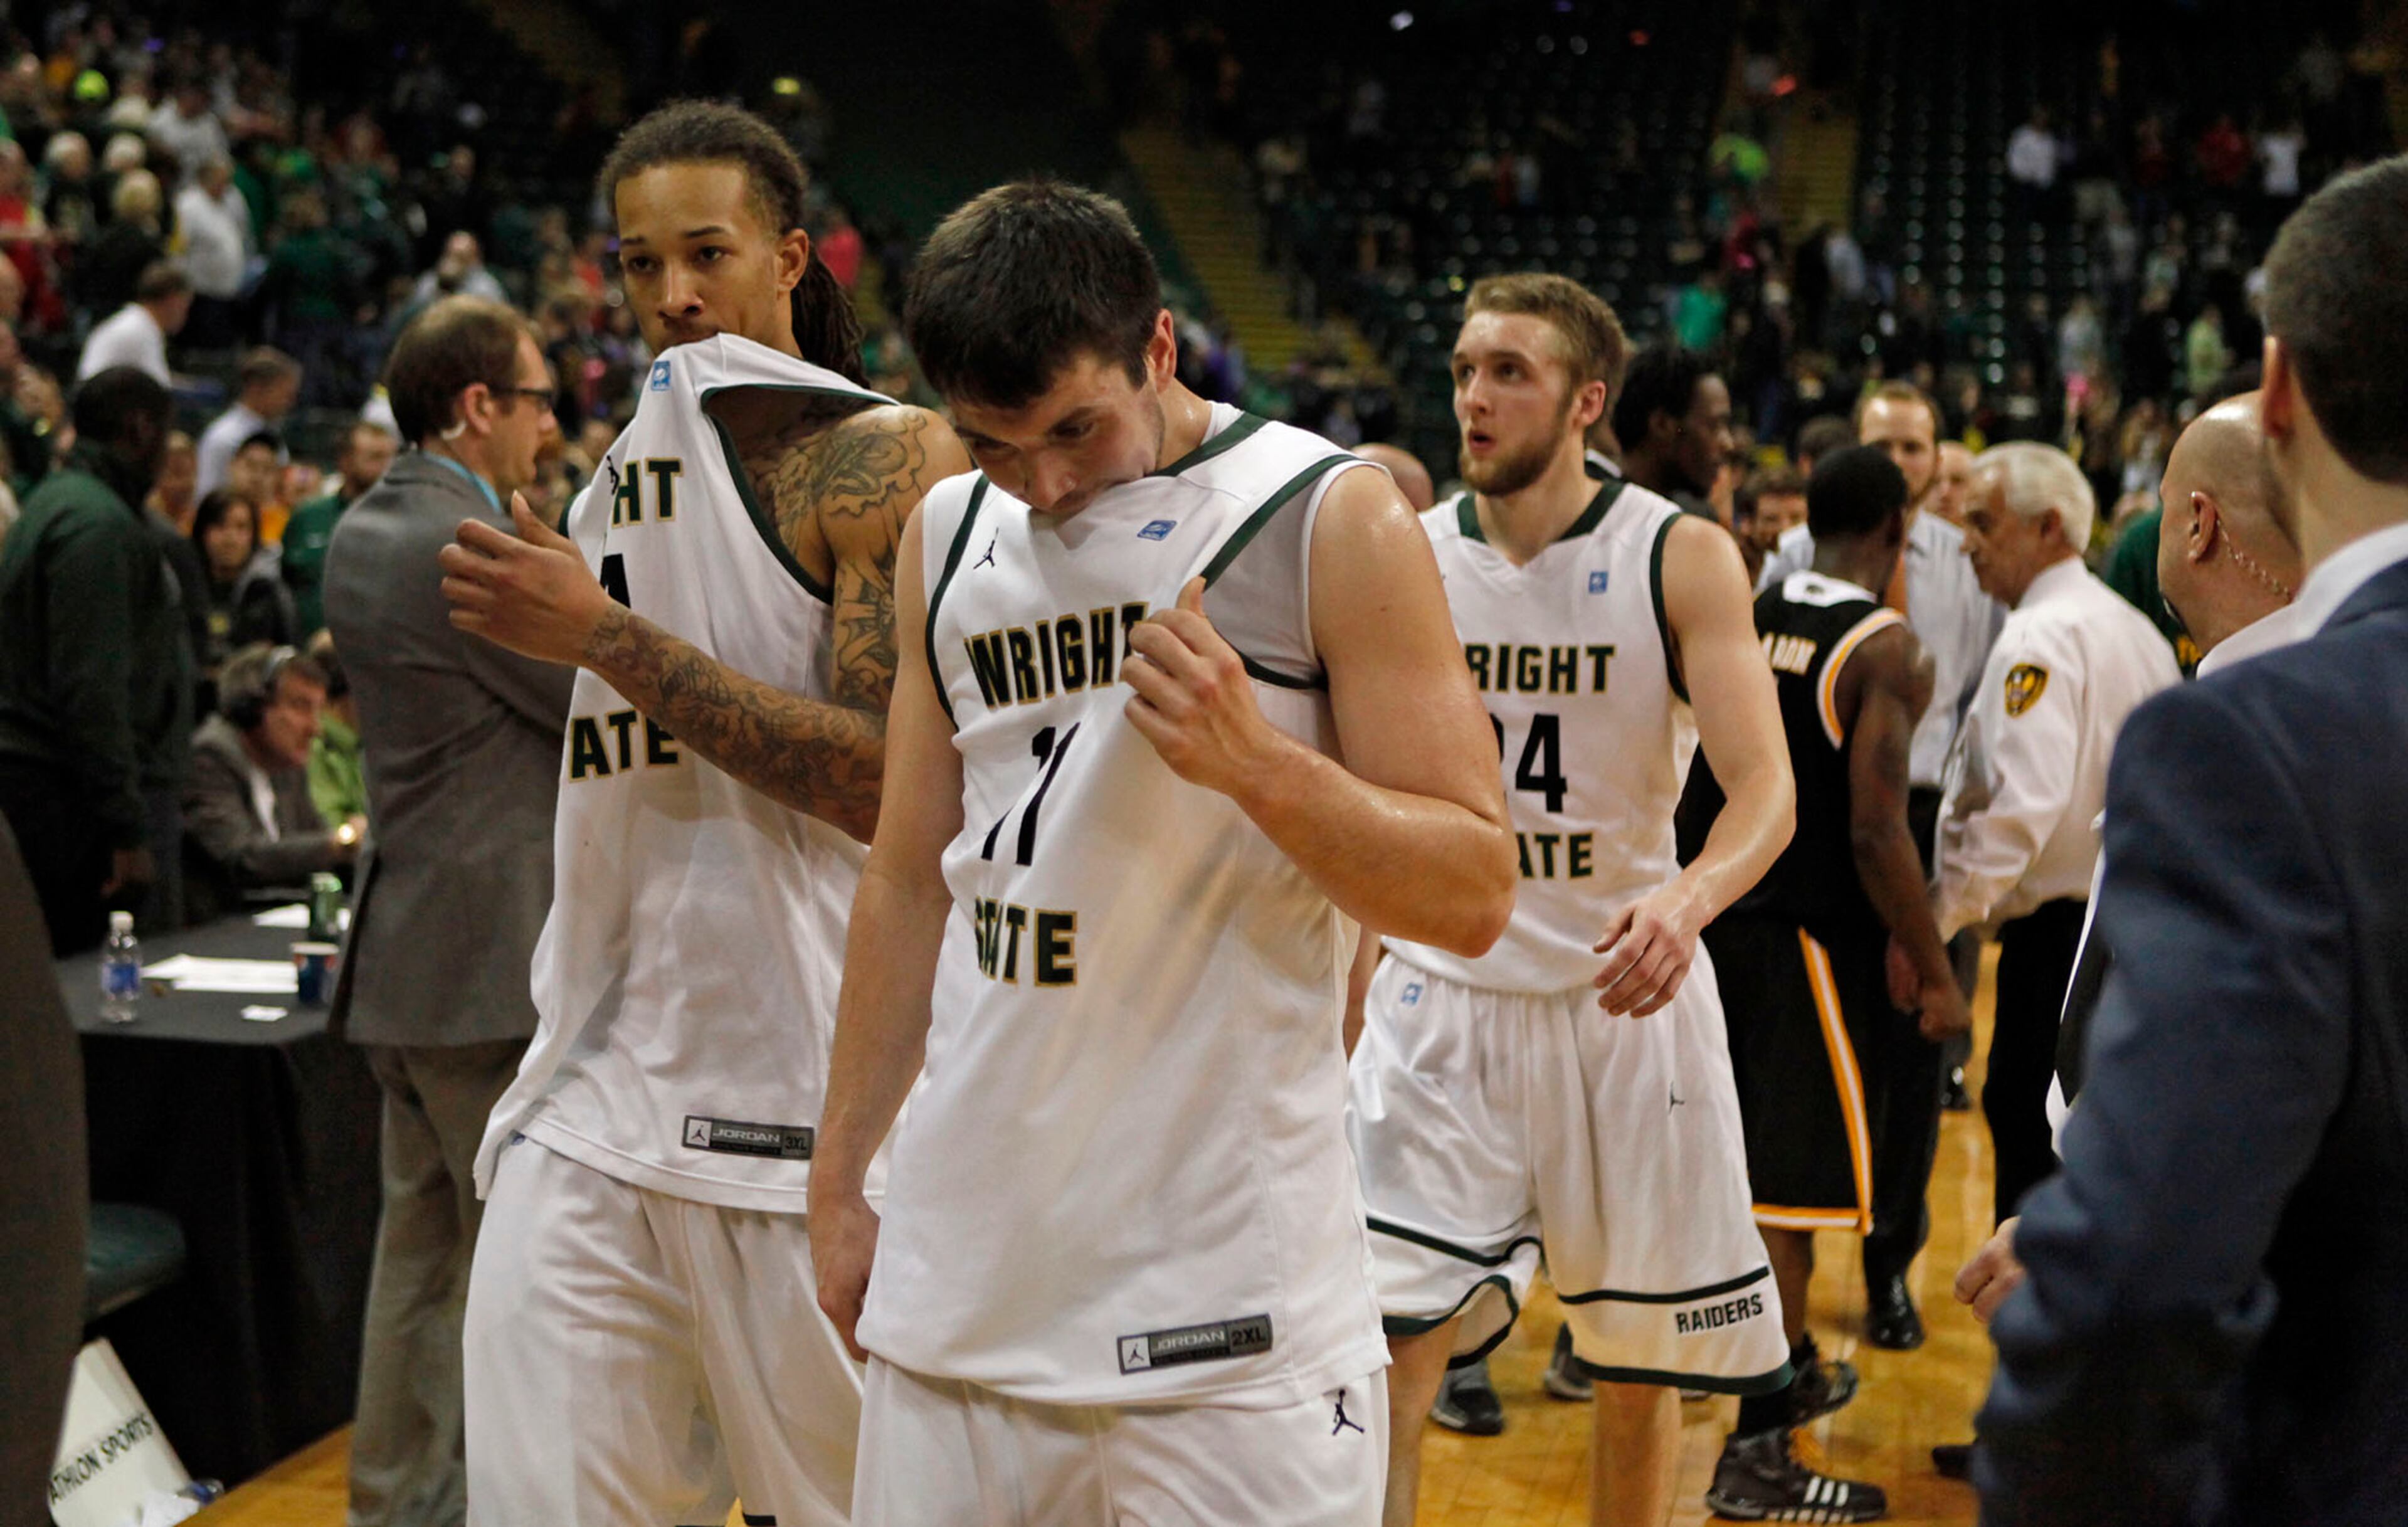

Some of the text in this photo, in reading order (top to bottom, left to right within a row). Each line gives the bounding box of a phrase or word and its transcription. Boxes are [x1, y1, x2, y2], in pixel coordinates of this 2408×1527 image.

[712, 1128, 780, 1143] JORDAN
[785, 1136, 807, 1151] 3XL
[1675, 1293, 1764, 1334] RAIDERS
[1153, 1324, 1266, 1351] JORDAN 2XL
[100, 1412, 152, 1464] SPORTS
